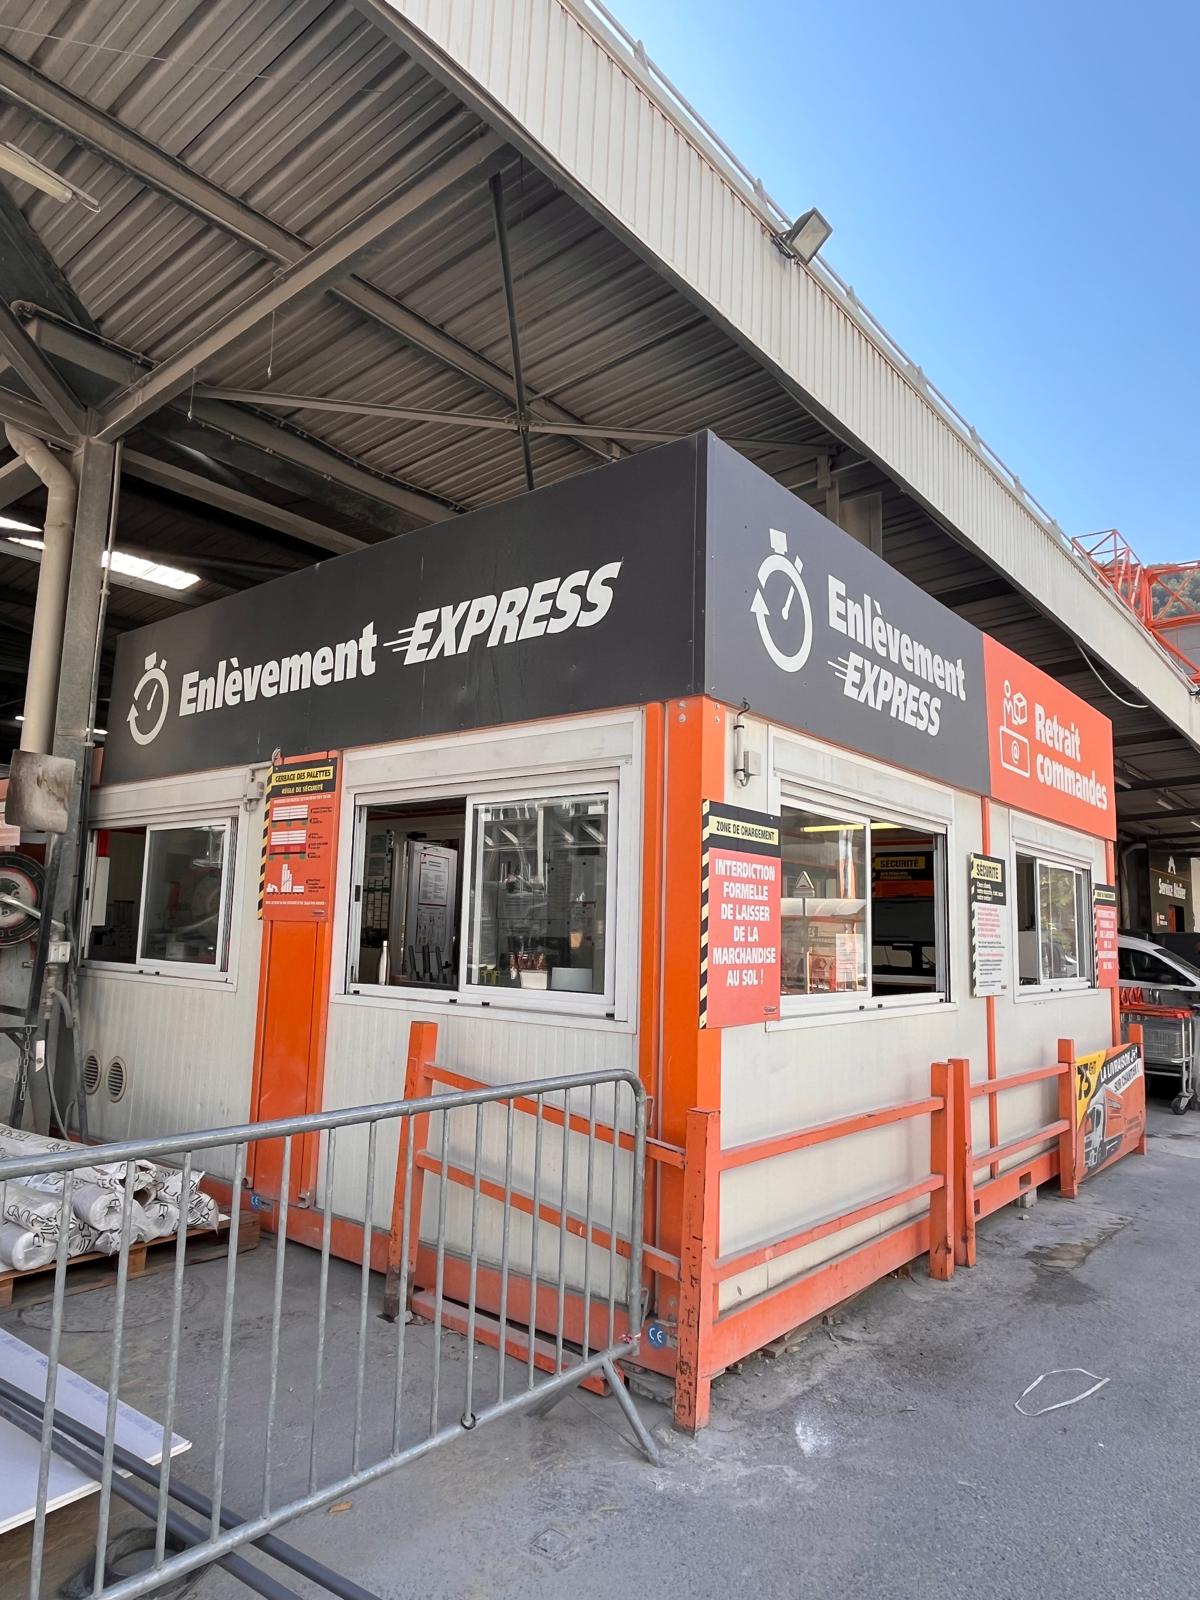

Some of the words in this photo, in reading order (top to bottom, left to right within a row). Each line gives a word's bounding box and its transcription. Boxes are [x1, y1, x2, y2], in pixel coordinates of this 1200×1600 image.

[179, 621, 378, 717] Enlèvement
[402, 561, 623, 666] EXPRESS
[828, 574, 967, 701] Enlèvement
[842, 651, 942, 737] EXPRESS
[1034, 702, 1081, 763] Retrait
[297, 772, 306, 780] DES
[307, 769, 331, 779] PALETTES
[1036, 753, 1108, 811] commandes
[716, 820, 731, 834] ZONE
[732, 823, 740, 835] DE
[740, 825, 775, 841] CHARGEMENT
[715, 858, 775, 882] INTERDICTION
[880, 857, 919, 868] SÉCURITÉ
[976, 861, 999, 880] SÉCURITÉ
[723, 881, 769, 901] FORMELLE
[721, 903, 734, 920] DE
[735, 905, 770, 922] LAISSER
[733, 926, 746, 942] DE
[747, 927, 759, 942] LA
[713, 947, 776, 965] MARCHANDISE
[726, 970, 740, 987] AU
[741, 969, 758, 986] SOL
[1100, 1066, 1107, 1083] LA
